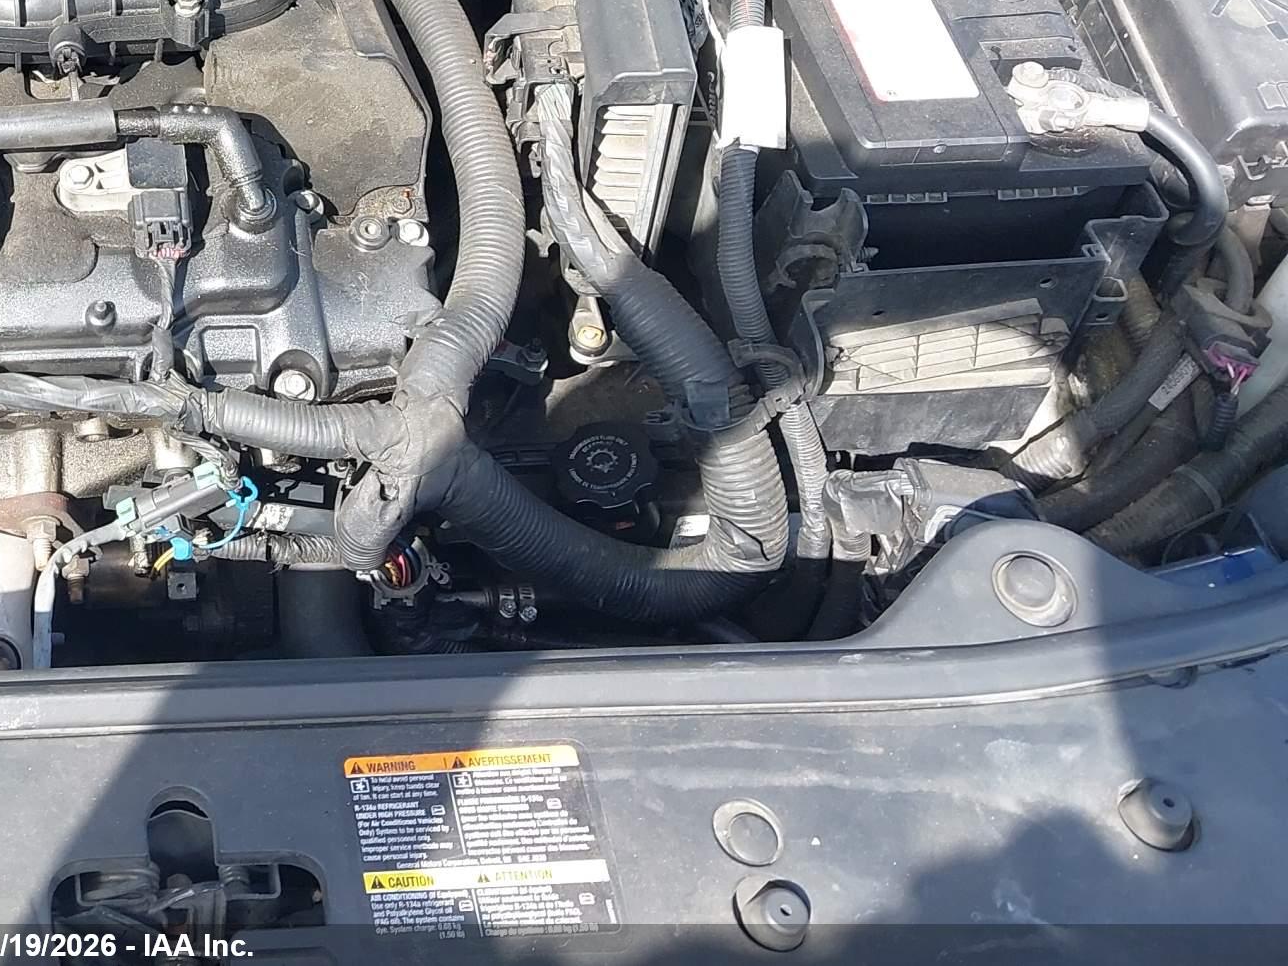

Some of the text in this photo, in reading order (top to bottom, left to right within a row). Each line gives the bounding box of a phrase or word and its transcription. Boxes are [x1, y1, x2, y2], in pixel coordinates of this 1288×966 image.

[469, 754, 550, 766] AVERTISSEMENT
[367, 761, 416, 772] WARNING
[396, 861, 419, 869] General
[494, 869, 553, 881] ATTENTION
[388, 876, 434, 888] CAUTION
[382, 892, 428, 901] CONDITIONING
[398, 901, 421, 909] R-134a
